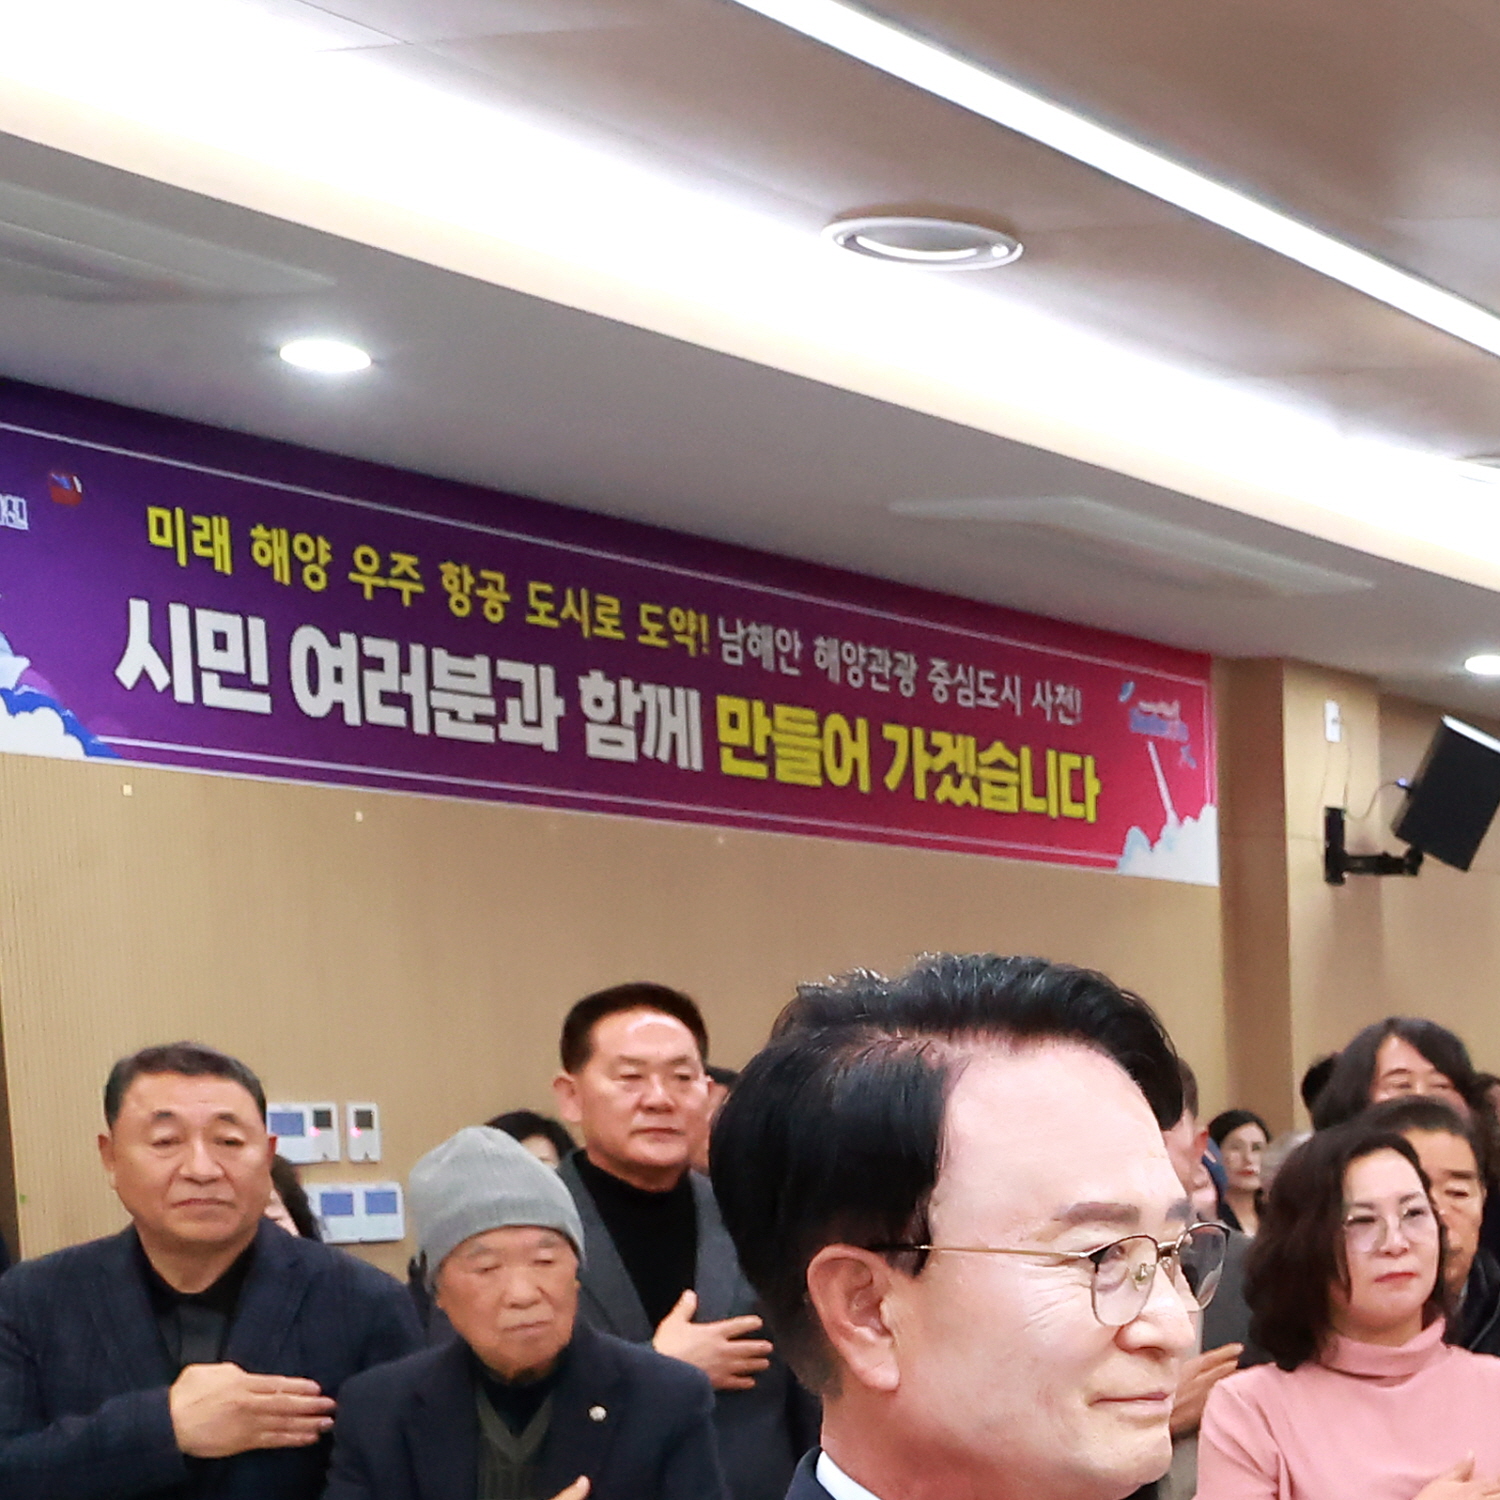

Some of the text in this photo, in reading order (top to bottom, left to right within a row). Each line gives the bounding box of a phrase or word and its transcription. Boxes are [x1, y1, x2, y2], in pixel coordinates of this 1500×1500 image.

[115, 597, 1102, 824] 시민 여러분과 함께 만들어 가겠습니다
[147, 504, 232, 575] 미래
[250, 523, 333, 592] 해양
[348, 545, 425, 607] 우주
[438, 561, 511, 624] 항공
[526, 580, 626, 640] 도시로
[637, 602, 710, 657] 도약!
[717, 615, 803, 677] 남해안
[812, 634, 919, 698] 해양관광
[926, 657, 1022, 717] 중심도시
